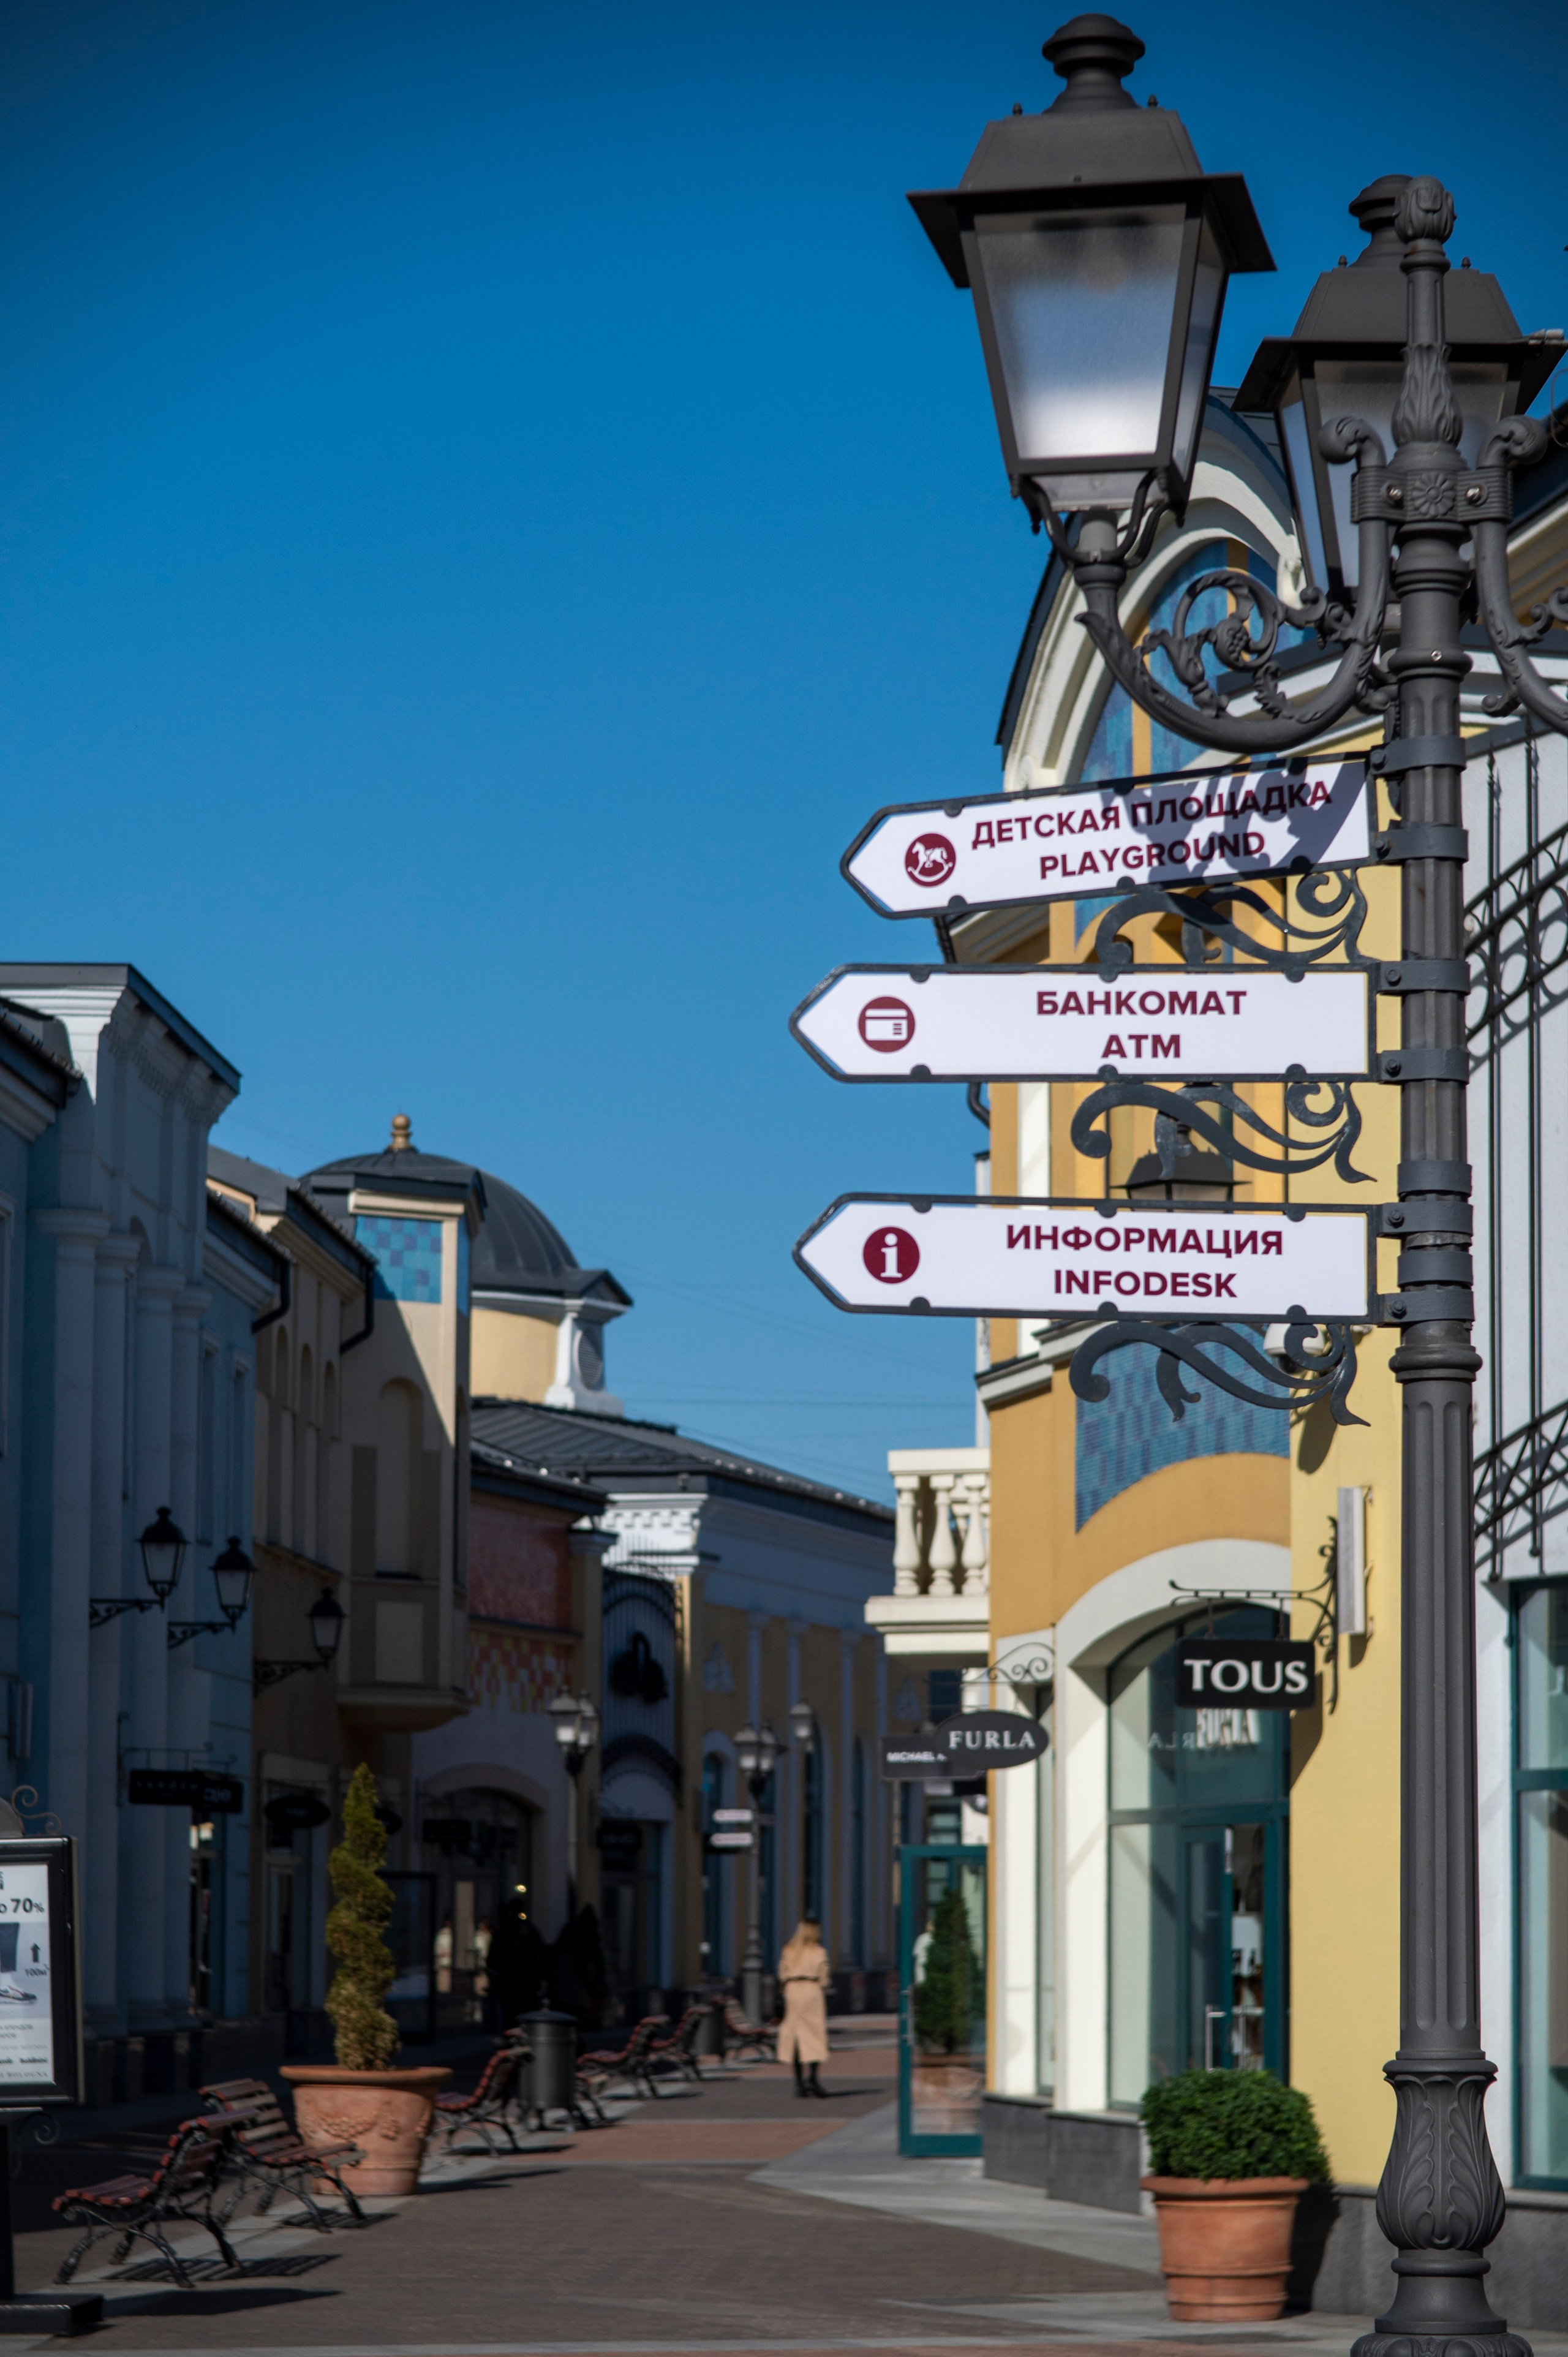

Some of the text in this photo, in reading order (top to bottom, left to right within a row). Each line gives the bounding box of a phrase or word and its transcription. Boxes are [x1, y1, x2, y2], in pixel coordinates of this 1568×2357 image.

[972, 781, 1332, 850] ДЕТСКАЯ ПЛОЩАДКА
[1040, 831, 1265, 880] PLAYGROUND
[1036, 990, 1247, 1016] БАНКОМАТ
[1102, 1034, 1181, 1058] ATM
[1007, 1224, 1283, 1259] ИНФОРМАЦИЯ
[1054, 1270, 1237, 1298] INFODESK
[1183, 1659, 1308, 1694] TOUS
[948, 1730, 1036, 1750] FURLA
[886, 1751, 936, 1763] MICHAEL
[10, 1898, 45, 1914] 70%
